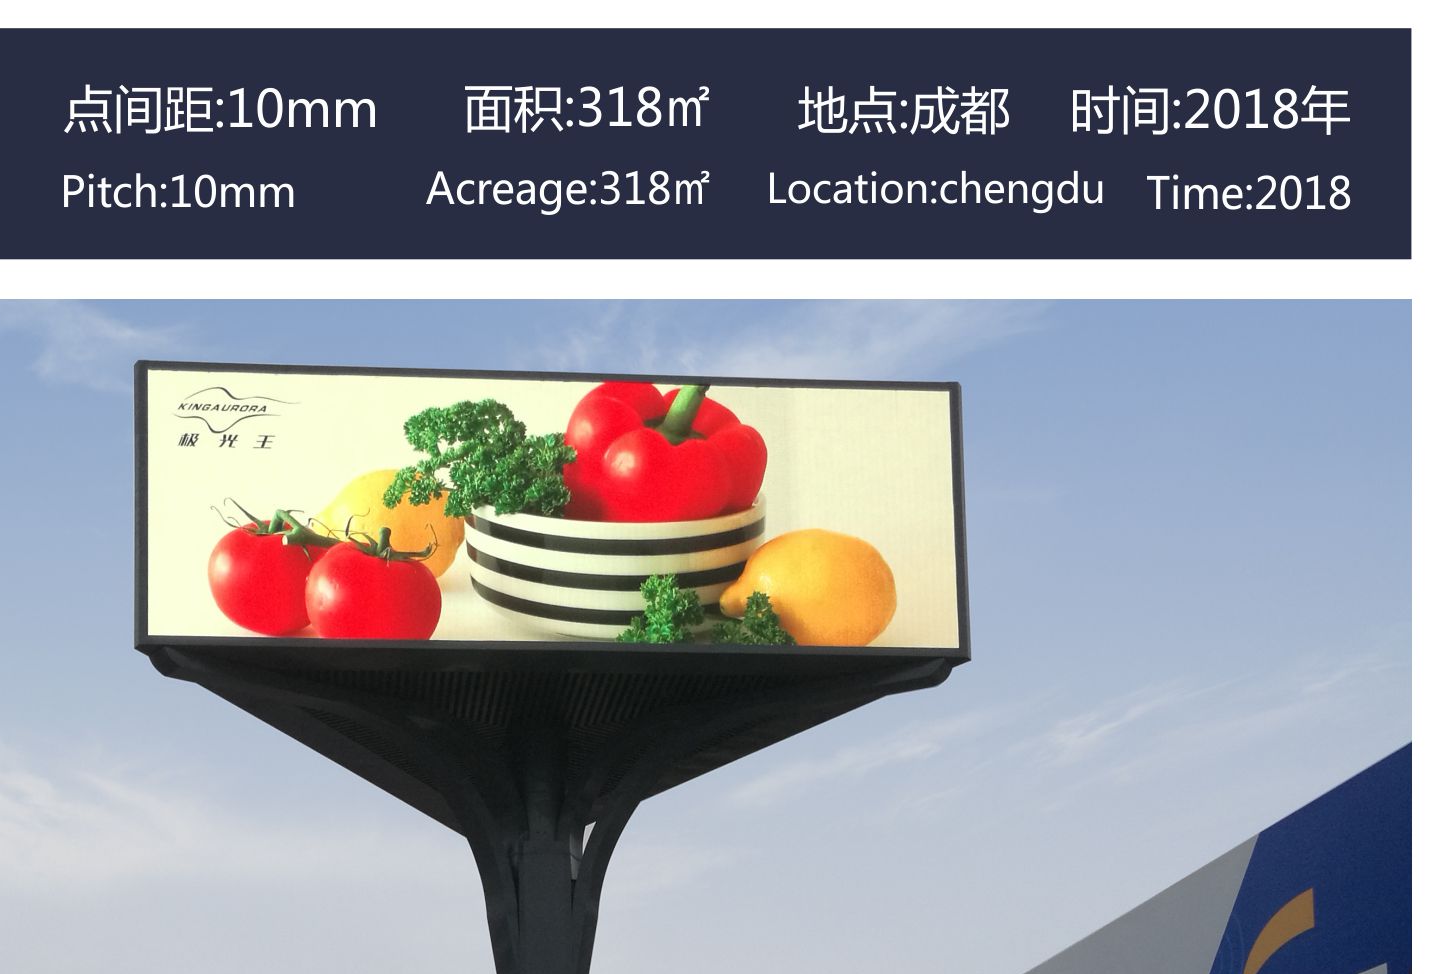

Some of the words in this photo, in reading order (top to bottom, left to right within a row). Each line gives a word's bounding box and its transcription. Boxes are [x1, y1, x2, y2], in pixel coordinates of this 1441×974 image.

[177, 402, 268, 413] KINGAURORA
[177, 432, 276, 450] 极光王
